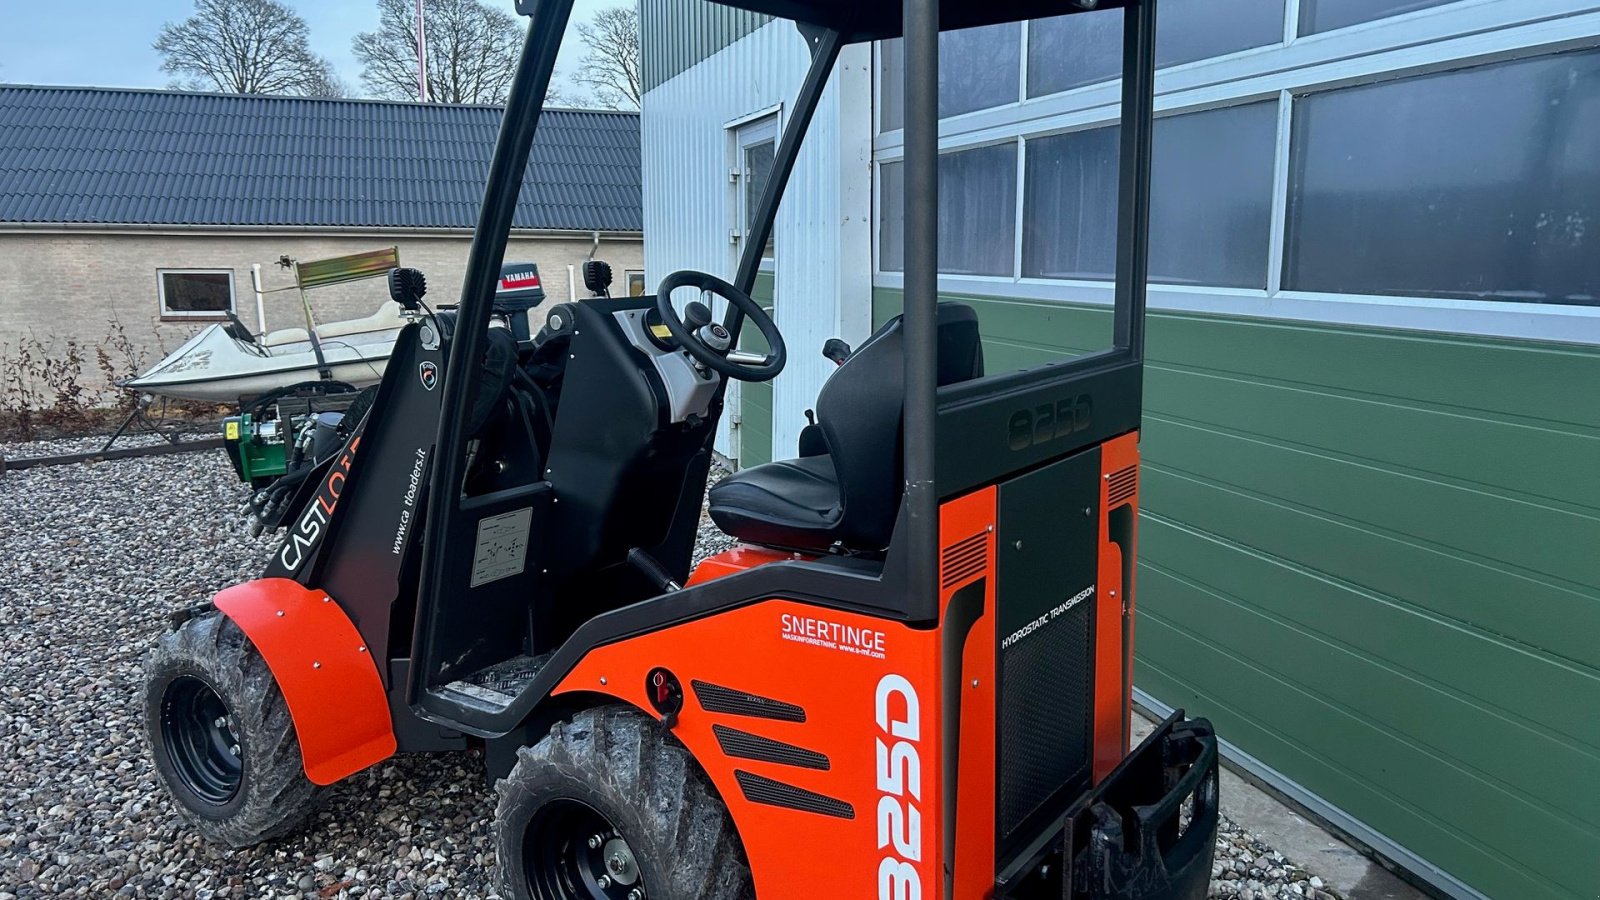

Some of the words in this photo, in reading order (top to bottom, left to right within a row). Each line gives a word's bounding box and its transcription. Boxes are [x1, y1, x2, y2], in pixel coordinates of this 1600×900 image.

[505, 271, 535, 283] YAMAHA
[781, 613, 886, 652] SNERTINGE
[1002, 613, 1049, 650] HYDROSTATIC
[1050, 584, 1095, 619] TRANSMISSION
[781, 632, 837, 649] MASKINFORRETNING
[875, 673, 922, 900] 825D
